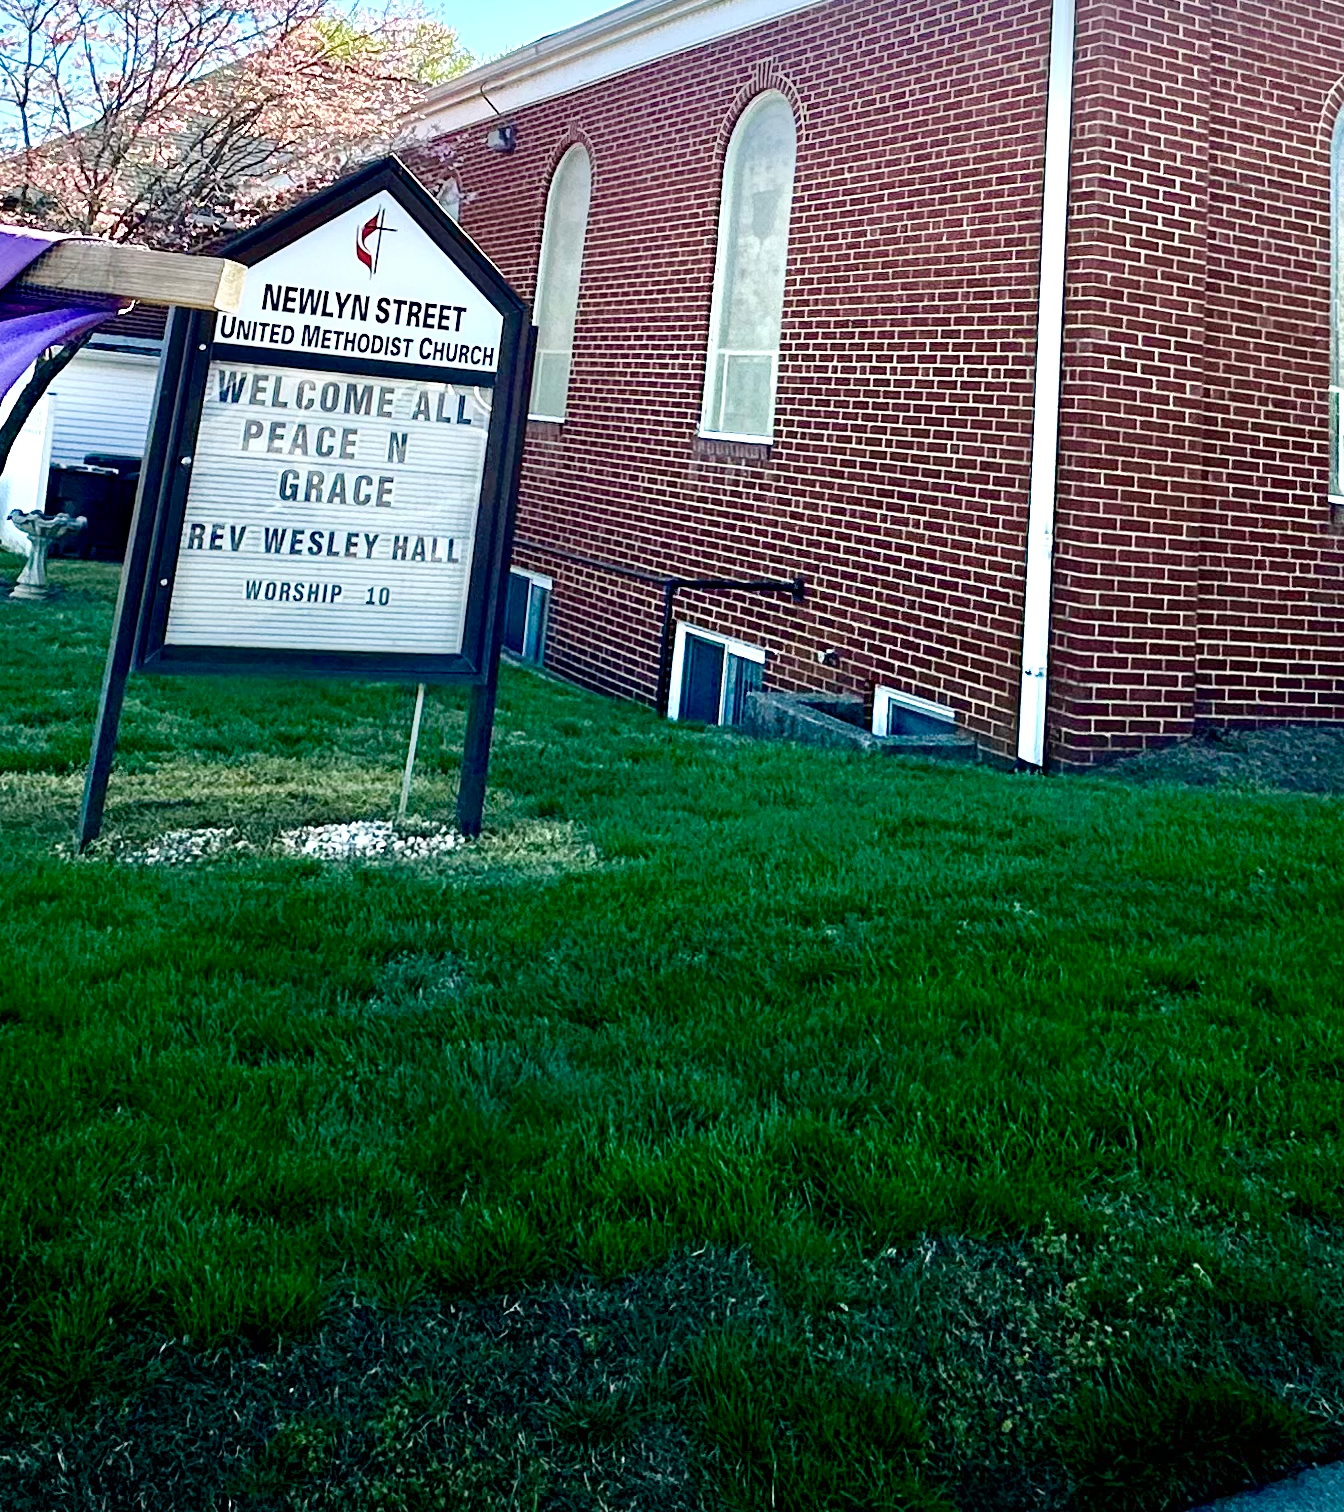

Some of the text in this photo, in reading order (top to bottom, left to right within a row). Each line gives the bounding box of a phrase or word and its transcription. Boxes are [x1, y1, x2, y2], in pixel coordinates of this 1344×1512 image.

[262, 284, 467, 332] NEWLYN STREET
[221, 316, 494, 367] UNITED METHODIST CHURCH
[218, 370, 473, 425] WELCOME ALL
[242, 420, 409, 464] PEACE N
[279, 469, 395, 508] GRACE
[188, 523, 460, 563] REV WESLEY HALL
[245, 580, 391, 606] WORSHIP 10
